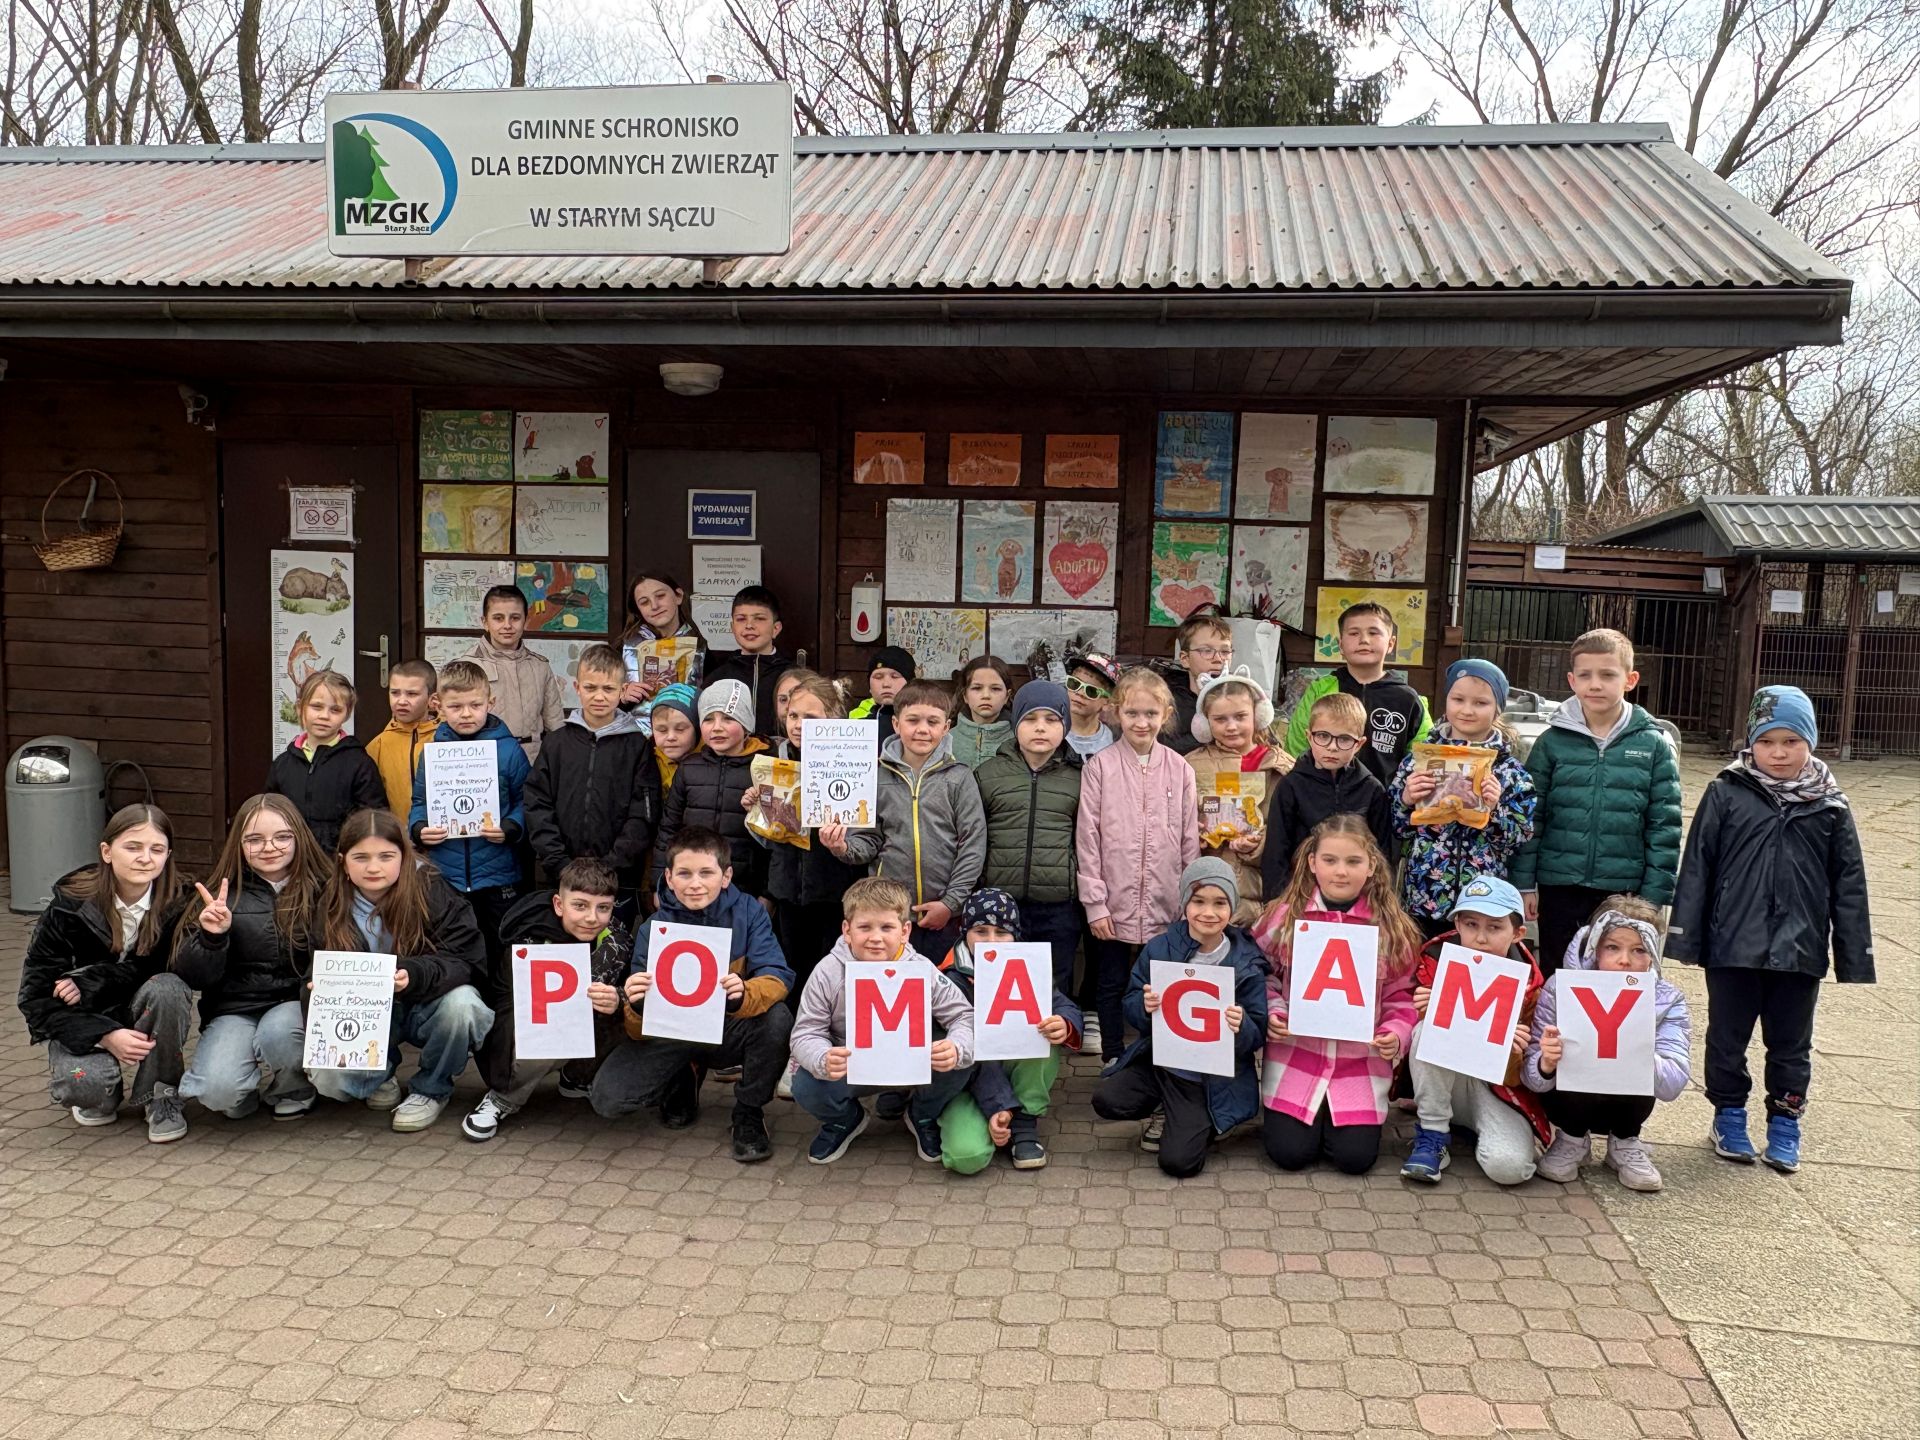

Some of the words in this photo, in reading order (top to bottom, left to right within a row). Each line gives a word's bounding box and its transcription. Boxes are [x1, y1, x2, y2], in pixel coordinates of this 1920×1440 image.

[507, 118, 595, 141] GMINNE
[601, 116, 740, 138] SCHRONISKO
[471, 156, 511, 177] DLA
[517, 154, 665, 176] BEZDOMNYCH
[671, 153, 779, 179] ZWIERZĄT
[346, 202, 430, 224] MZGK
[530, 207, 551, 228] W
[557, 207, 642, 228] STARYM
[648, 206, 716, 232] SĄCZU
[384, 225, 407, 233] Stary
[693, 505, 750, 513] WYDAWANIE
[697, 516, 746, 526] ZWIERZĄT
[815, 725, 865, 737] DYPLOM
[437, 746, 485, 758] DYPLOM
[325, 959, 382, 972] DYPLOM
[655, 940, 719, 1008] O
[1302, 938, 1366, 1007] A
[529, 959, 579, 1024] P
[986, 958, 1042, 1025] A
[1432, 960, 1521, 1046] M
[854, 977, 927, 1049] M
[1160, 978, 1222, 1043] G
[1569, 986, 1643, 1060] Y
